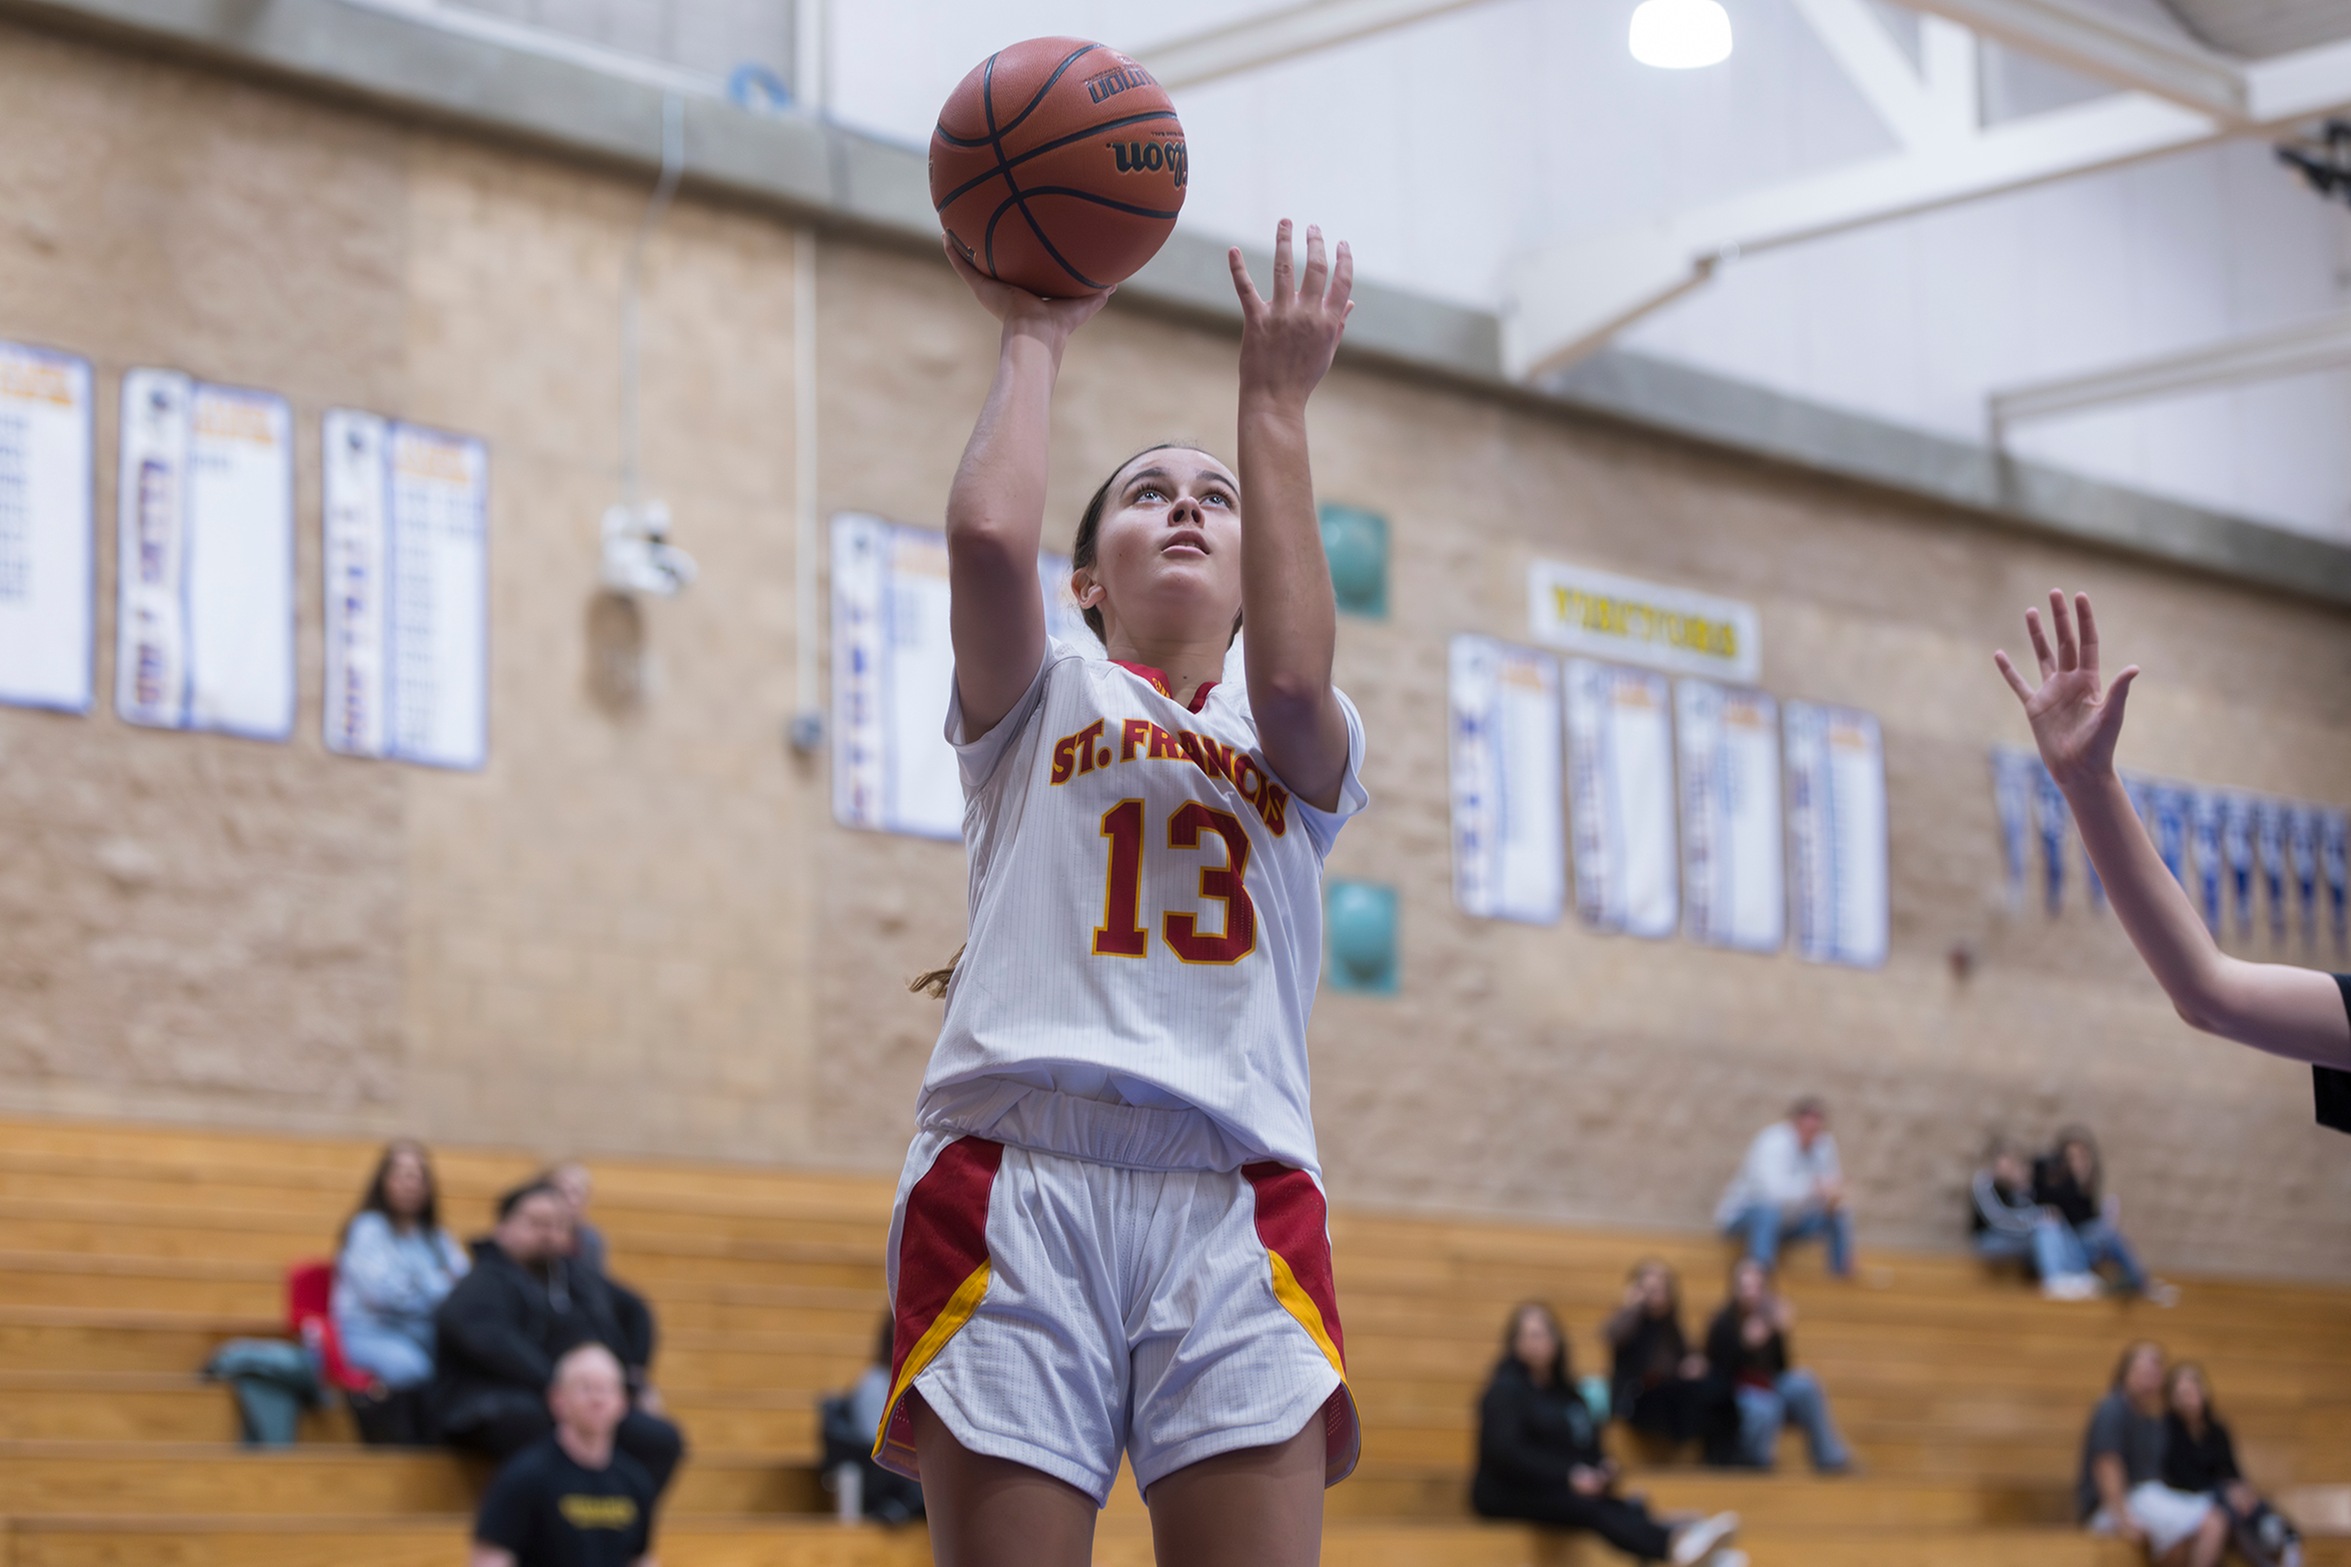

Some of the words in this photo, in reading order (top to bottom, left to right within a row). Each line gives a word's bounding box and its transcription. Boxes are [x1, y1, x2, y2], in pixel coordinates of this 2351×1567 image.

[1107, 141, 1188, 190] ilson
[1050, 717, 1112, 786] ST.
[1119, 718, 1290, 838] FRANCIS
[1092, 798, 1258, 965] 13
